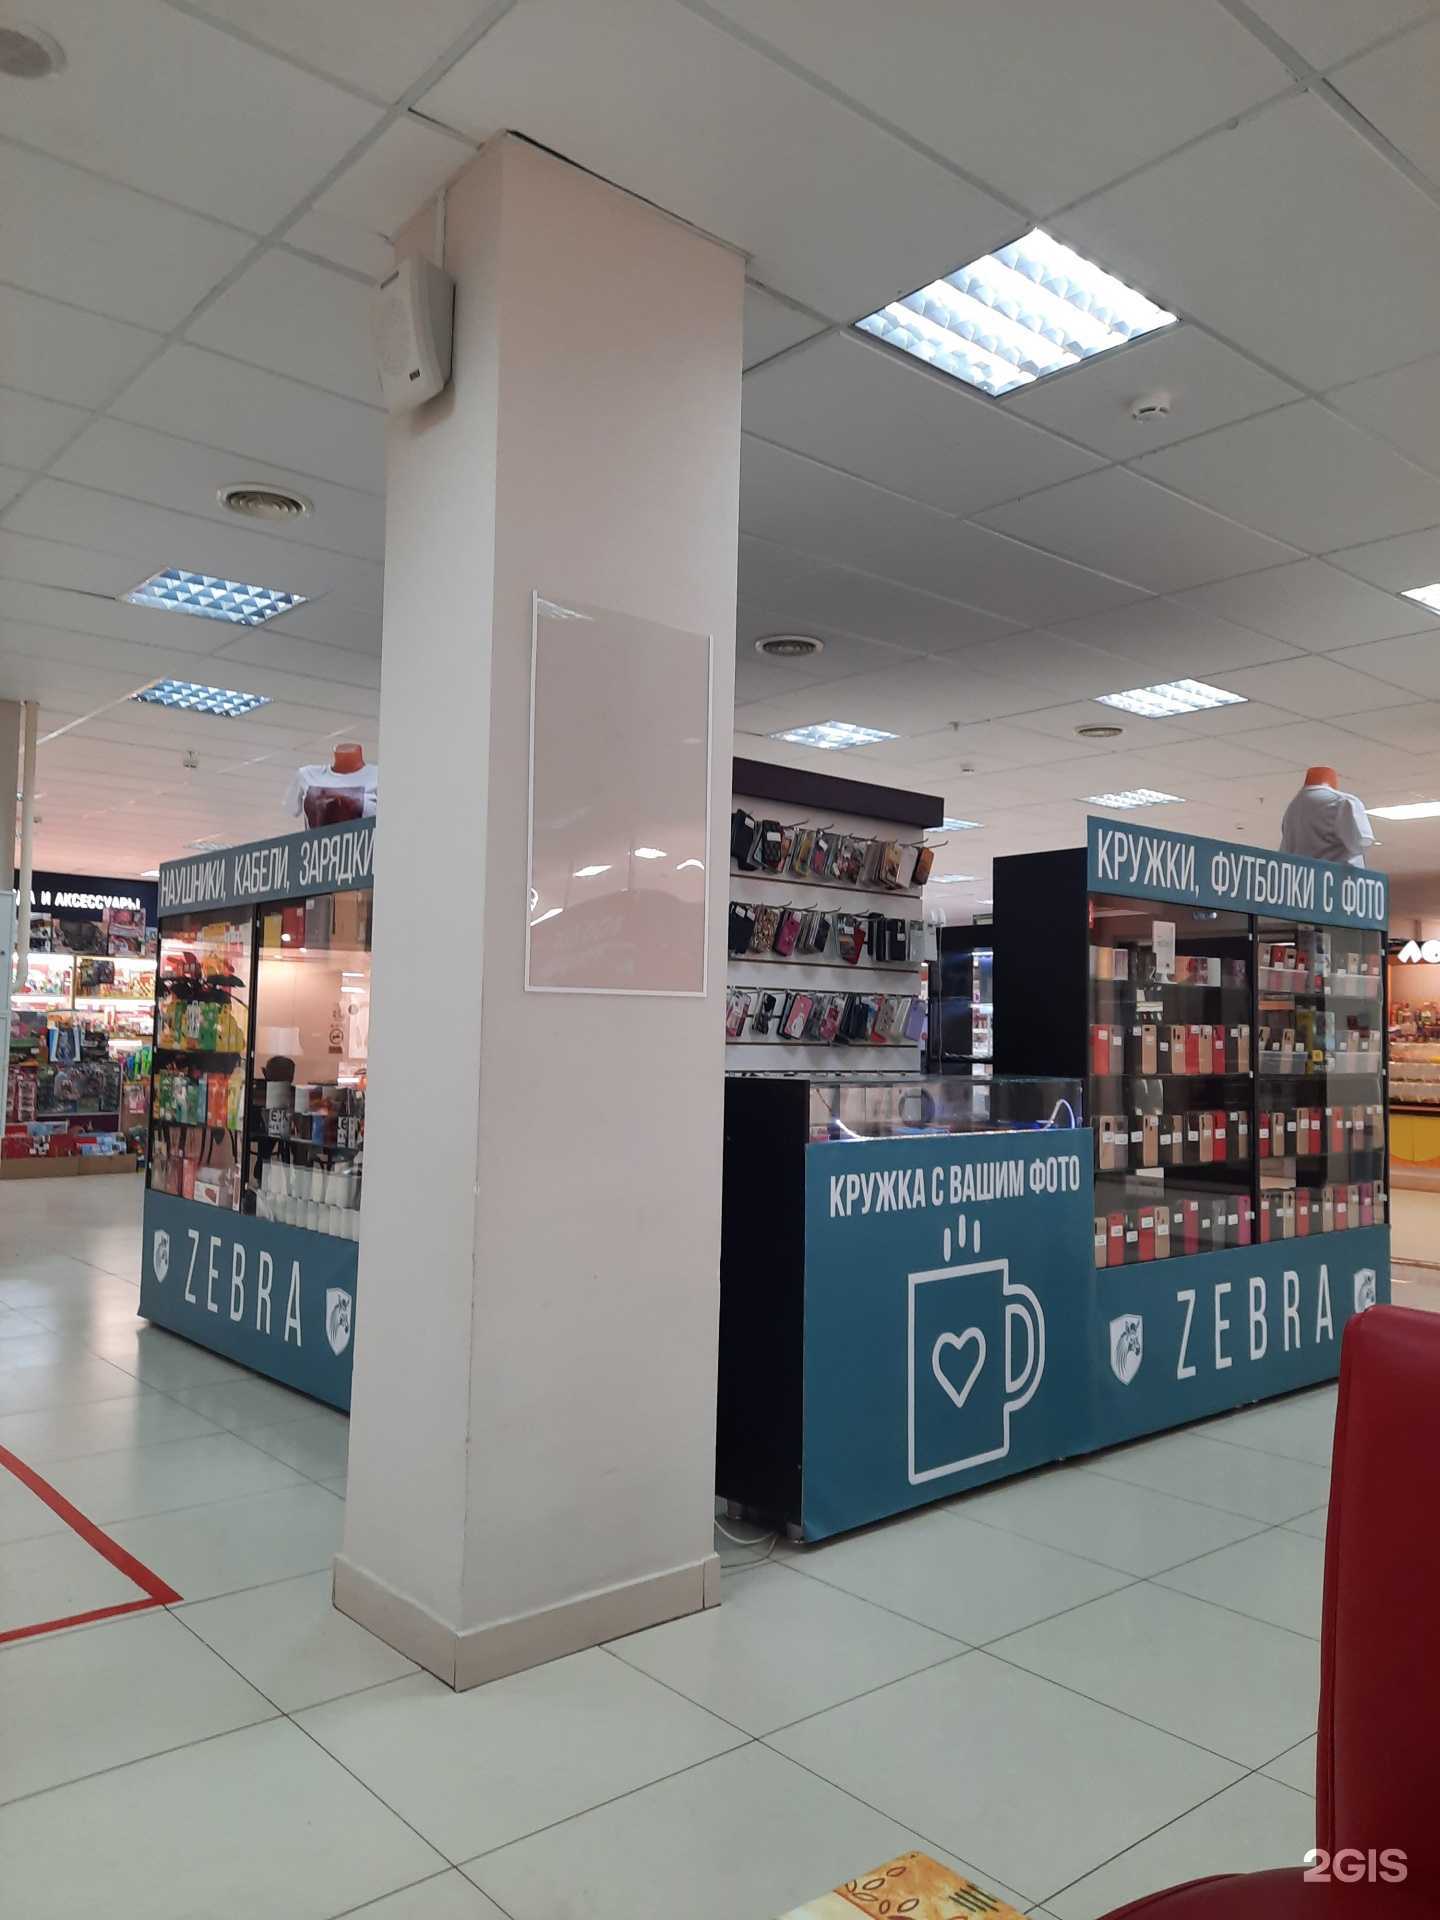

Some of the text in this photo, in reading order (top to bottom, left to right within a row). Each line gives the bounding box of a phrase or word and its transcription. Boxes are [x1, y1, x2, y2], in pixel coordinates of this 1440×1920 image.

[160, 858, 226, 907] НАУШНИКИ,
[233, 845, 290, 894] КАБЕЛИ,
[1098, 829, 1384, 921] КРУЖКИ, ФУТБОЛКИ С ФОТО
[830, 1155, 1080, 1218] КРУЖКА С ВАШИМ ФОТО
[185, 1228, 302, 1347] ZEBRA
[1176, 1264, 1334, 1380] ZEBRA
